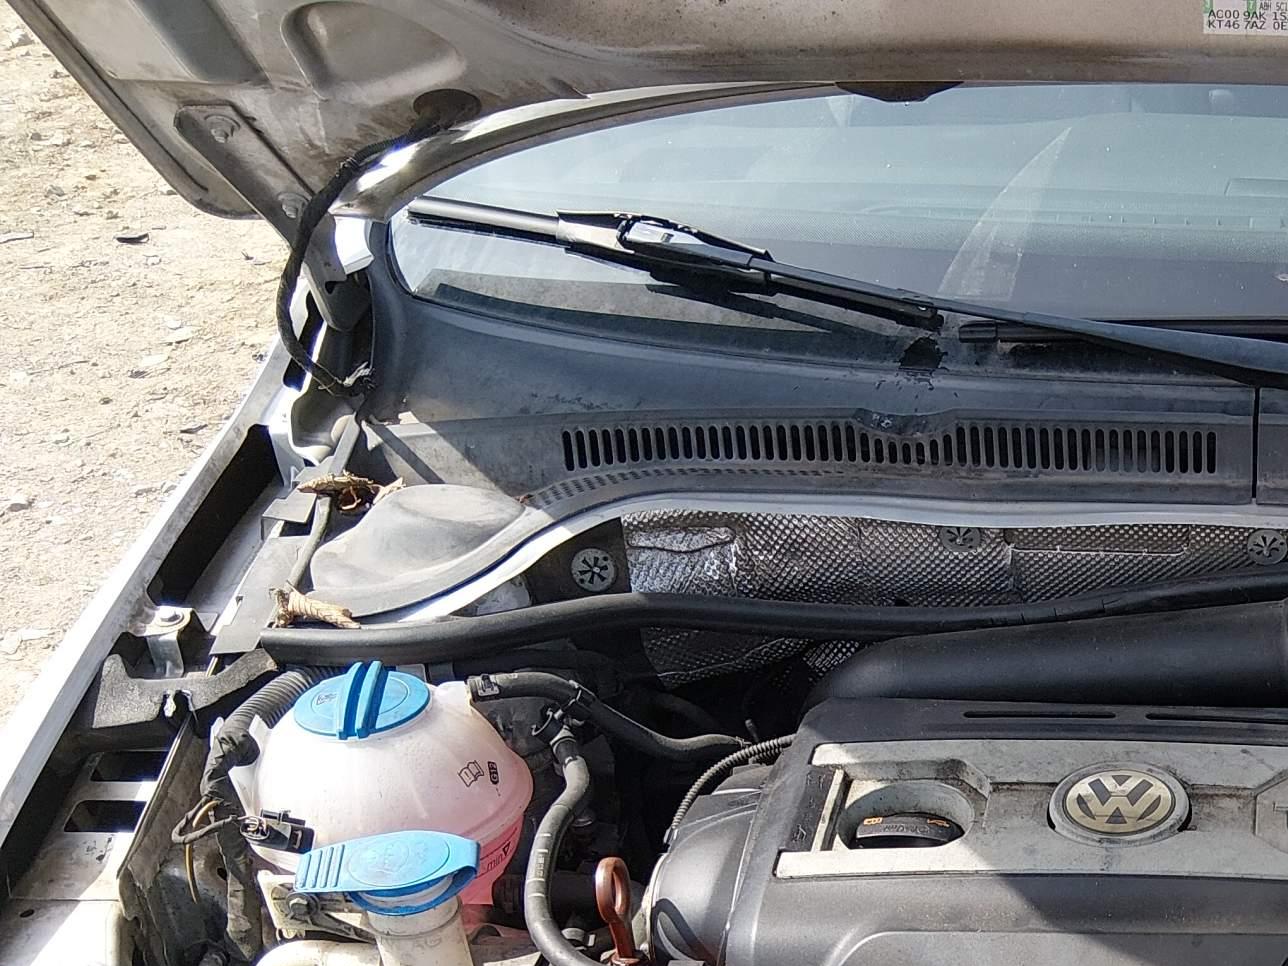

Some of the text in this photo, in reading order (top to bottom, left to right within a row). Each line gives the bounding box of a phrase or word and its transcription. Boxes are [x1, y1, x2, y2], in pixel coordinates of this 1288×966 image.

[1208, 20, 1240, 29] KT46
[1244, 21, 1266, 29] 7AZ
[1243, 11, 1266, 20] 9AK
[489, 762, 499, 782] G12
[1065, 769, 1176, 835] VW
[487, 853, 504, 873] min
